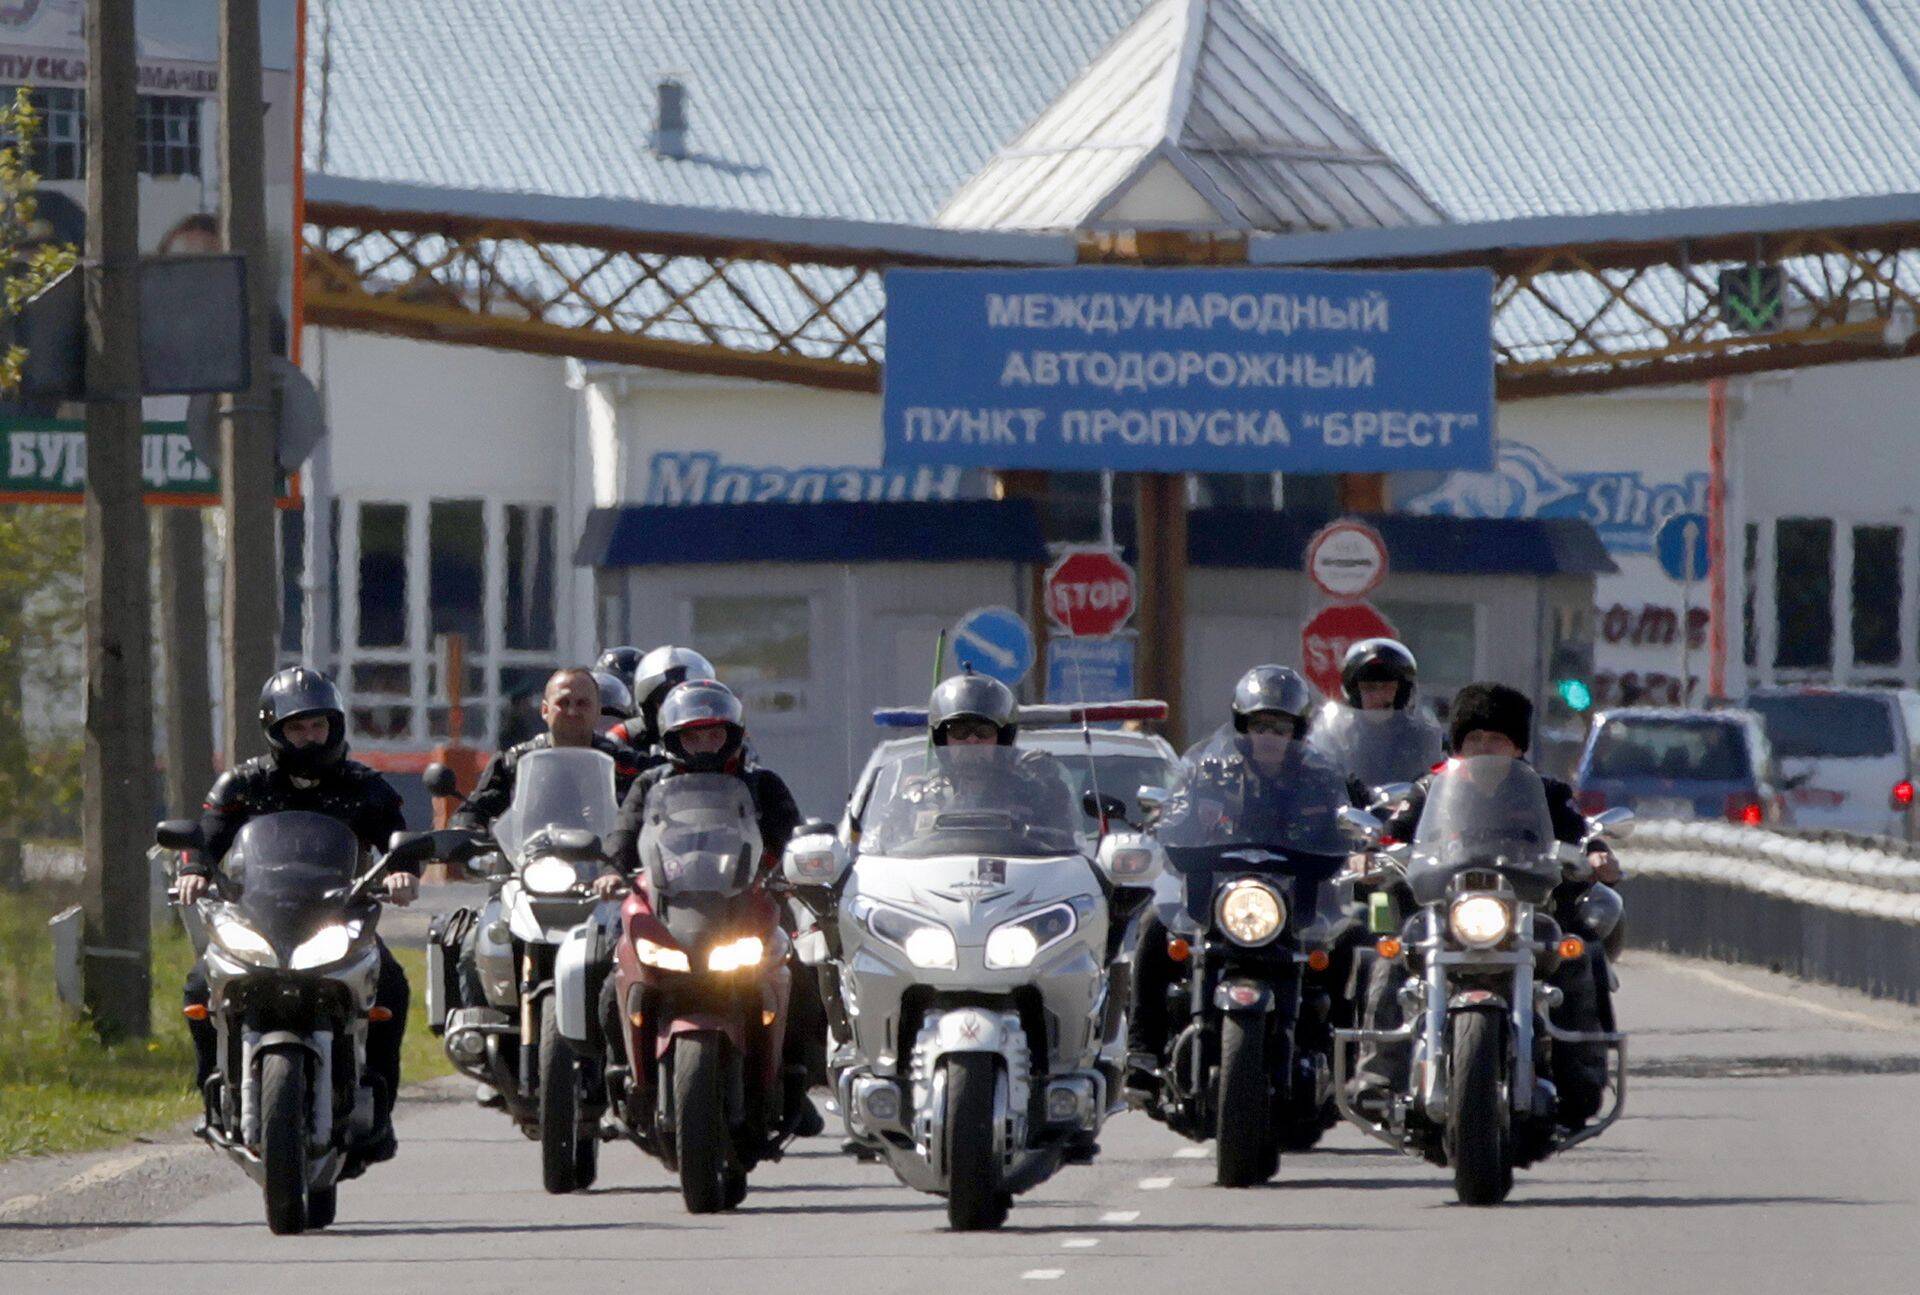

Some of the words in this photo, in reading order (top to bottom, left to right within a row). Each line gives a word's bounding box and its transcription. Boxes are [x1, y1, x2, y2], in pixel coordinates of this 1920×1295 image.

[987, 291, 1389, 333] МЕЖДУНАРОДНЫЙ
[1000, 349, 1376, 391] АВТОДОРОЖНЫЙ
[903, 408, 1045, 442] ПУНКТ
[1061, 410, 1292, 445] ПРОПУСКА
[1055, 580, 1130, 611] STOP
